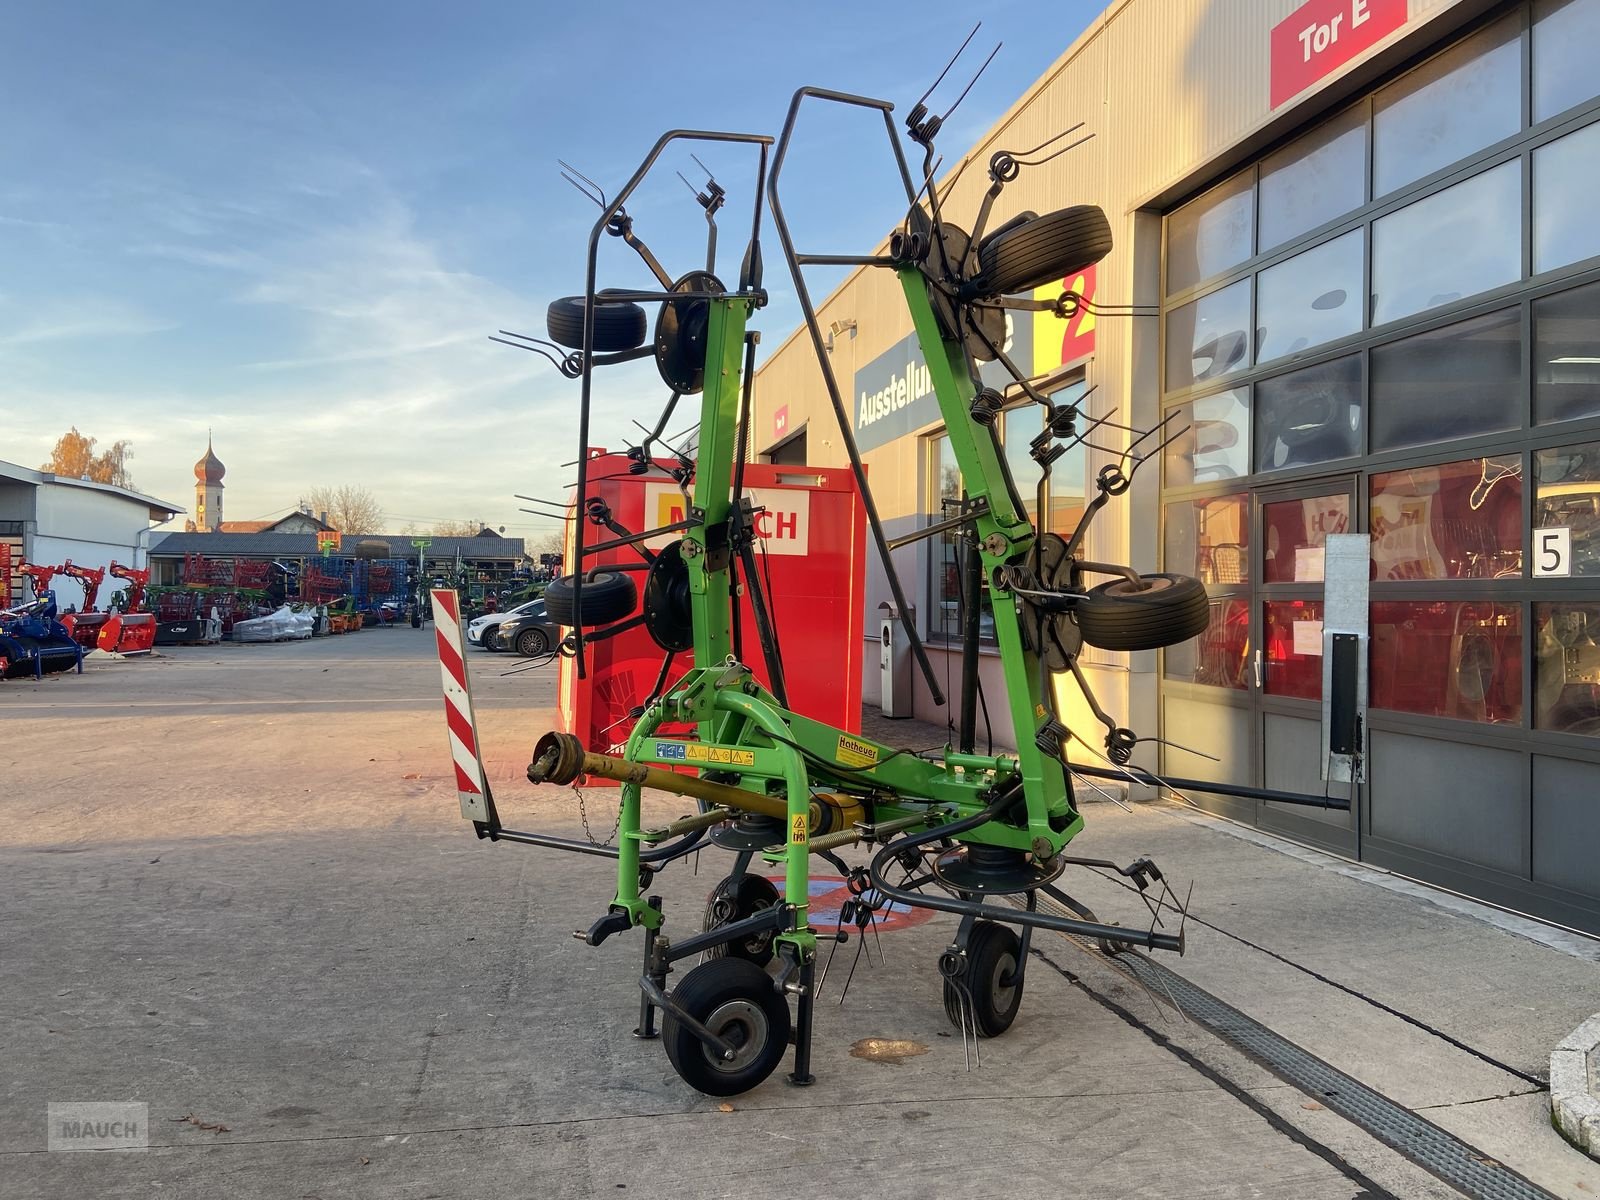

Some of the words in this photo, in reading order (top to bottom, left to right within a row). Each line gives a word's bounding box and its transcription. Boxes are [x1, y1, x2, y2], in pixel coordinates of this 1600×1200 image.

[1298, 12, 1343, 62] Tor
[1352, 0, 1370, 30] E
[858, 360, 936, 430] Ausstellun
[1541, 534, 1561, 572] 5
[839, 736, 877, 759] Hatheuer
